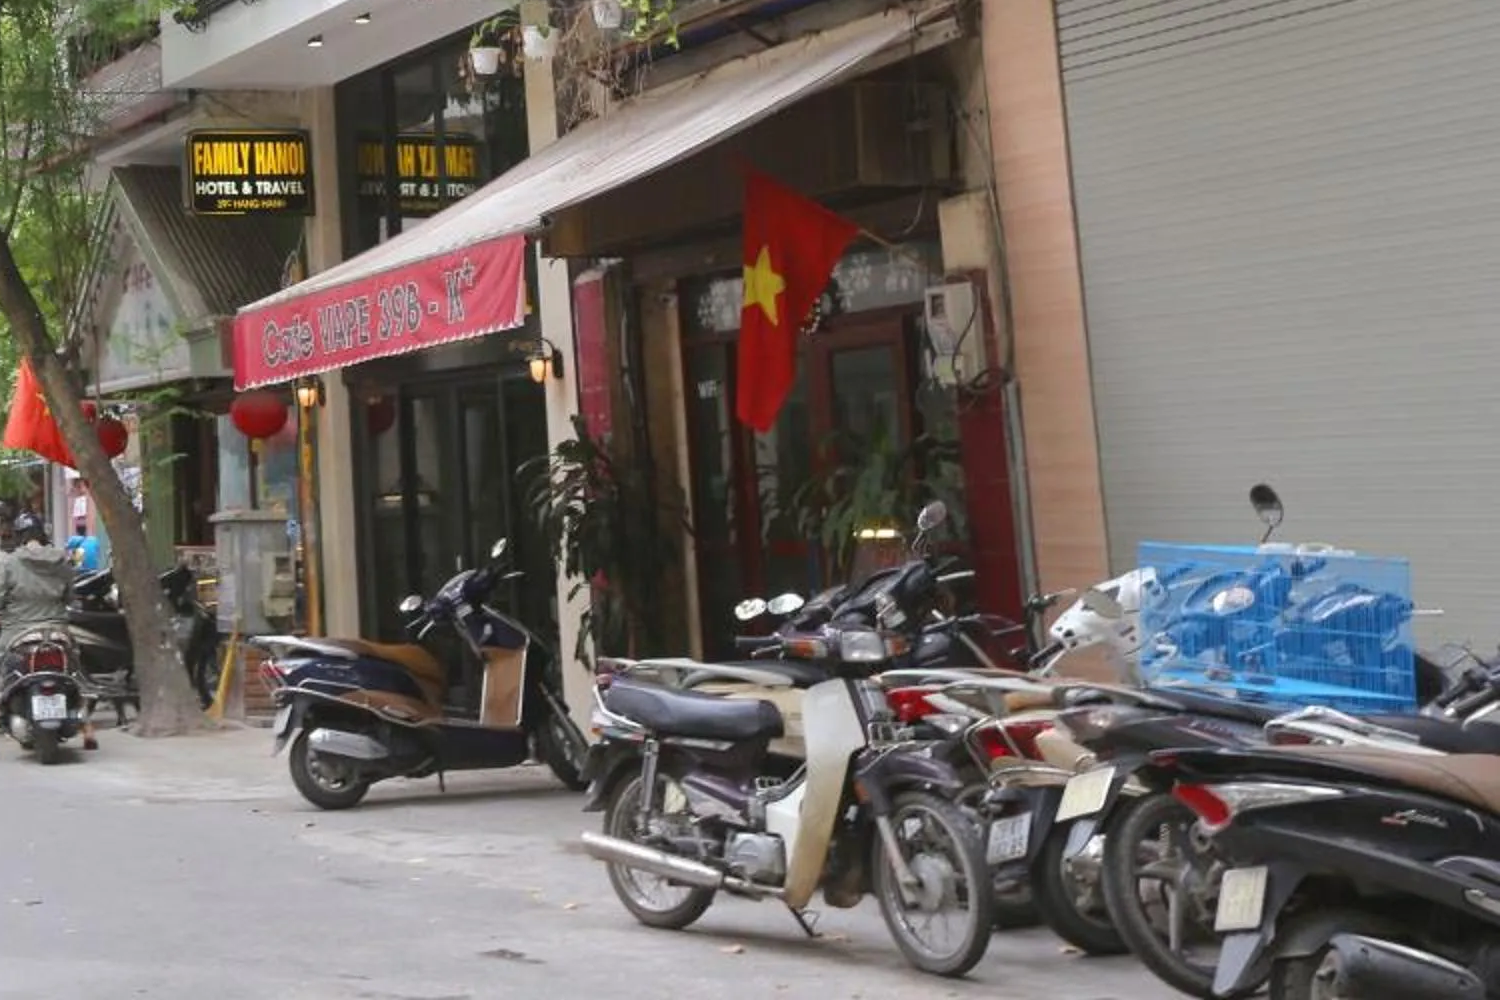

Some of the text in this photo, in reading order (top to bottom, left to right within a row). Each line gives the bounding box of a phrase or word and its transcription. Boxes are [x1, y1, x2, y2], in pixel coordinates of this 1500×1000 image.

[193, 141, 306, 176] FAMILY HANOI
[195, 180, 305, 196] HOTEL & TRAVEL
[317, 296, 371, 355] VAPE
[377, 280, 423, 341] 39B
